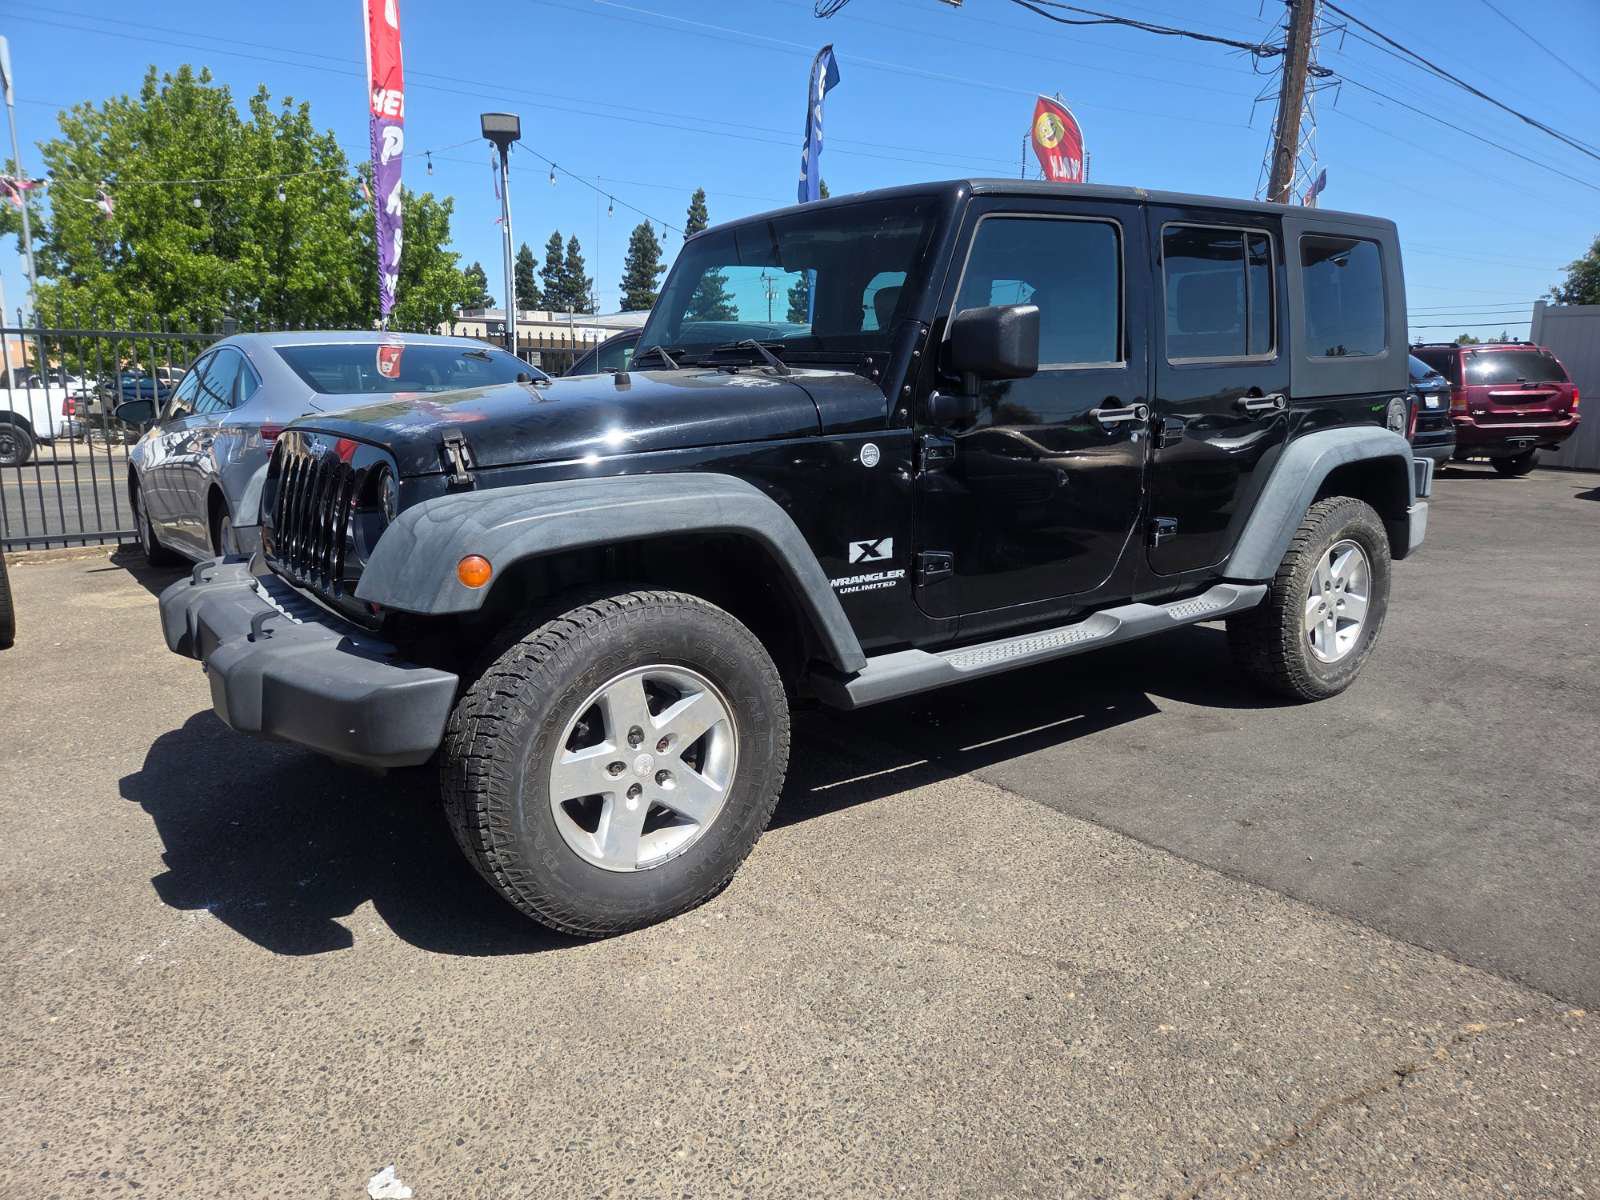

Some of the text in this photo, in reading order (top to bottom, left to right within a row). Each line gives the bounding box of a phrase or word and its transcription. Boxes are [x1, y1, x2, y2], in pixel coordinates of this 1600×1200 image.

[852, 537, 887, 563] X
[830, 569, 905, 588] WRANGLER
[839, 580, 897, 594] UNLIMITED
